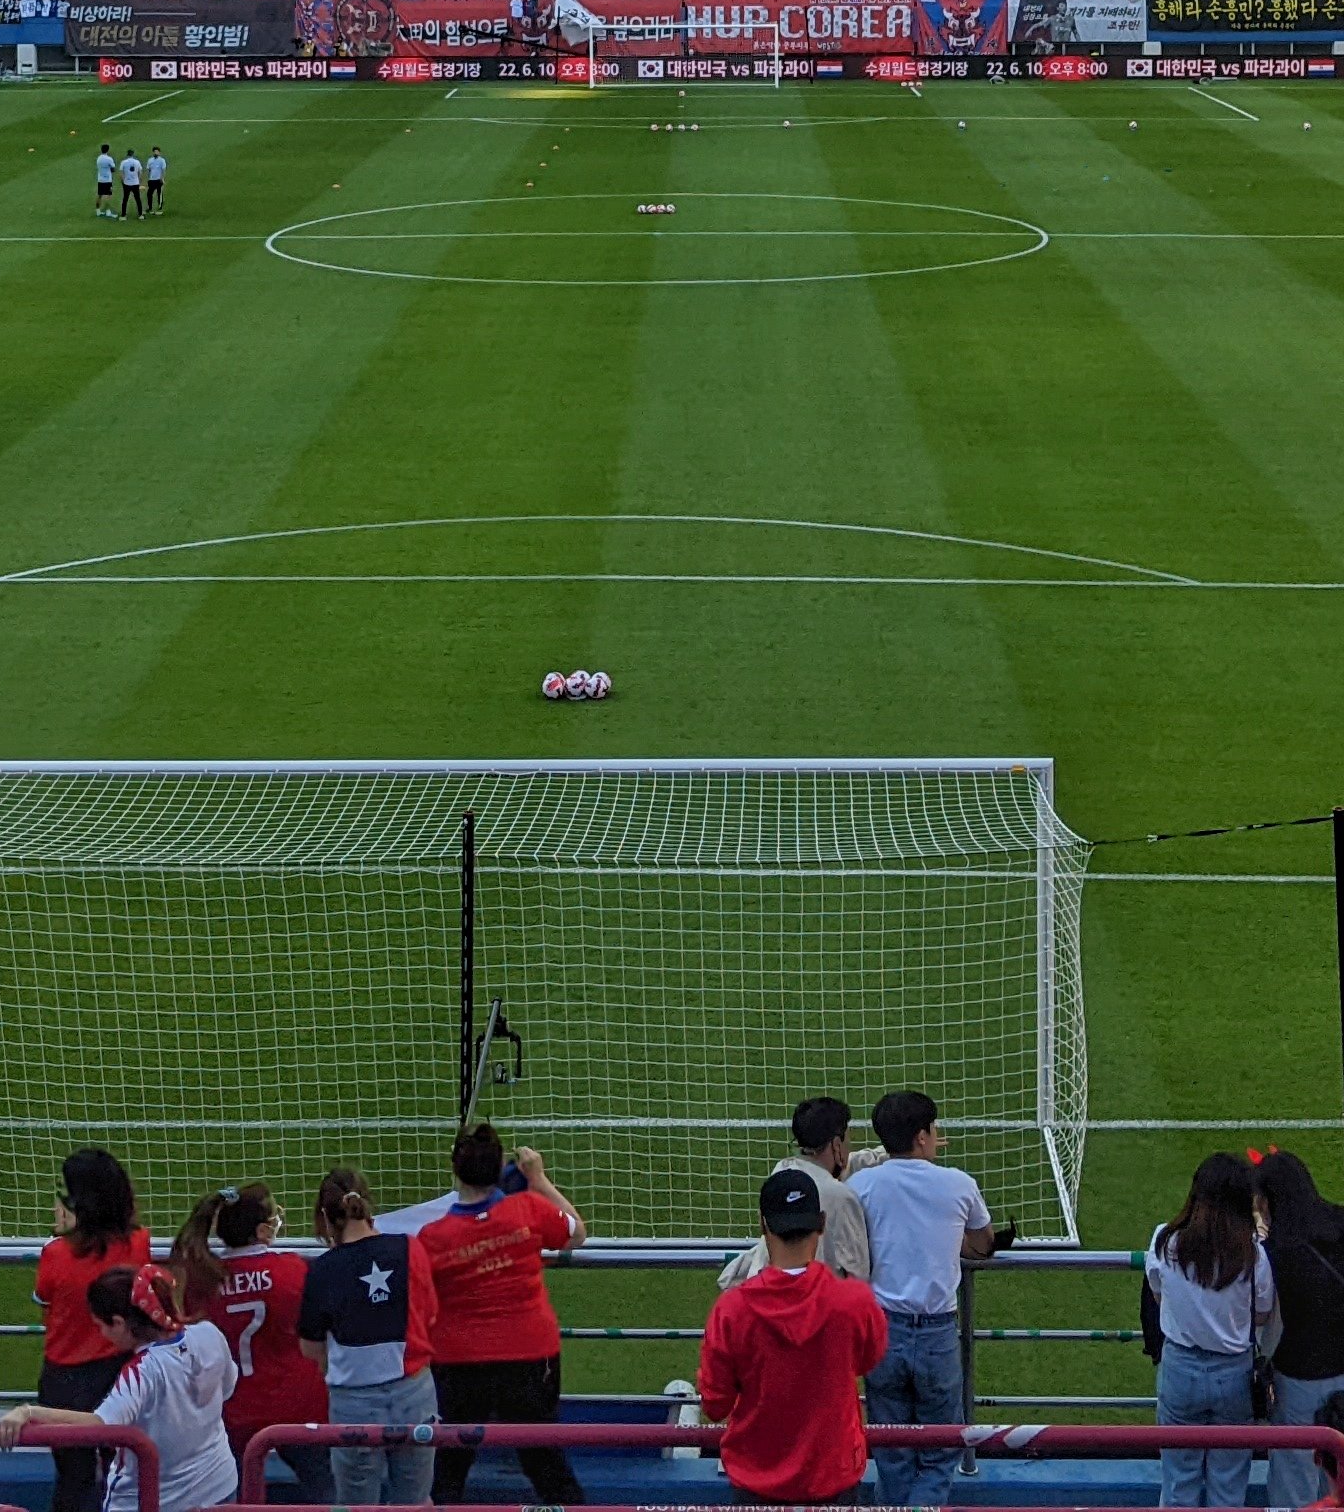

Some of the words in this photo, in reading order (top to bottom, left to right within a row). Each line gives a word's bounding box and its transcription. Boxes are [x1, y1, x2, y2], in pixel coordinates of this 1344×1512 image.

[70, 6, 132, 22] 비상하라!
[779, 5, 911, 39] COREA
[80, 24, 137, 47] 대전의
[141, 24, 180, 47] 아들
[185, 24, 249, 47] 황인범!
[102, 64, 133, 78] 8:00
[180, 61, 240, 79] 대한민국
[245, 65, 264, 77] vs
[267, 61, 327, 79] 파라과이
[377, 62, 482, 78] 수원월드컵경기장
[560, 62, 587, 77] 오후
[667, 60, 726, 78] 대한민국
[731, 65, 750, 76] vs
[753, 60, 814, 78] 파라과이
[865, 61, 968, 78] 수원월드컵경기장
[1049, 61, 1074, 76] 오후
[1078, 62, 1108, 75] 8:00
[1156, 59, 1217, 76] 대한민국
[1221, 64, 1240, 75] vs
[1244, 58, 1305, 76] 파라과이
[226, 1300, 266, 1377] 7
